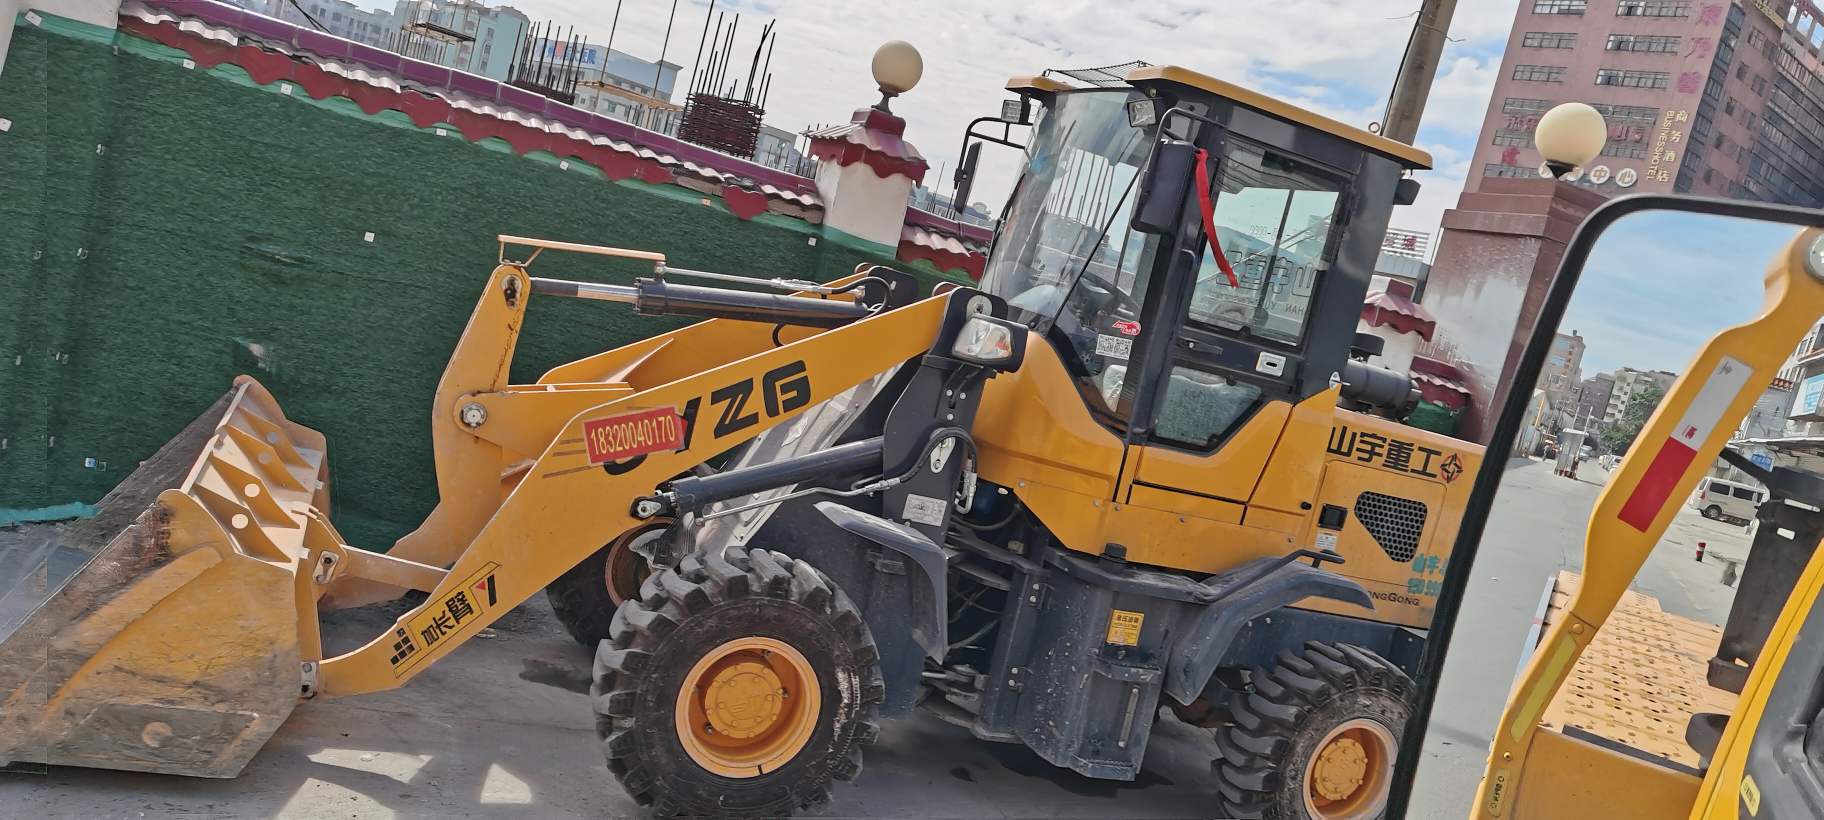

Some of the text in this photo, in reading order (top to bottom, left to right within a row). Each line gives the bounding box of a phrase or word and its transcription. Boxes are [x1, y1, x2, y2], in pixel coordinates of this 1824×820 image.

[590, 415, 676, 455] 18320040170
[1326, 425, 1442, 479] 山宇重工
[421, 590, 474, 647] 加长臂
